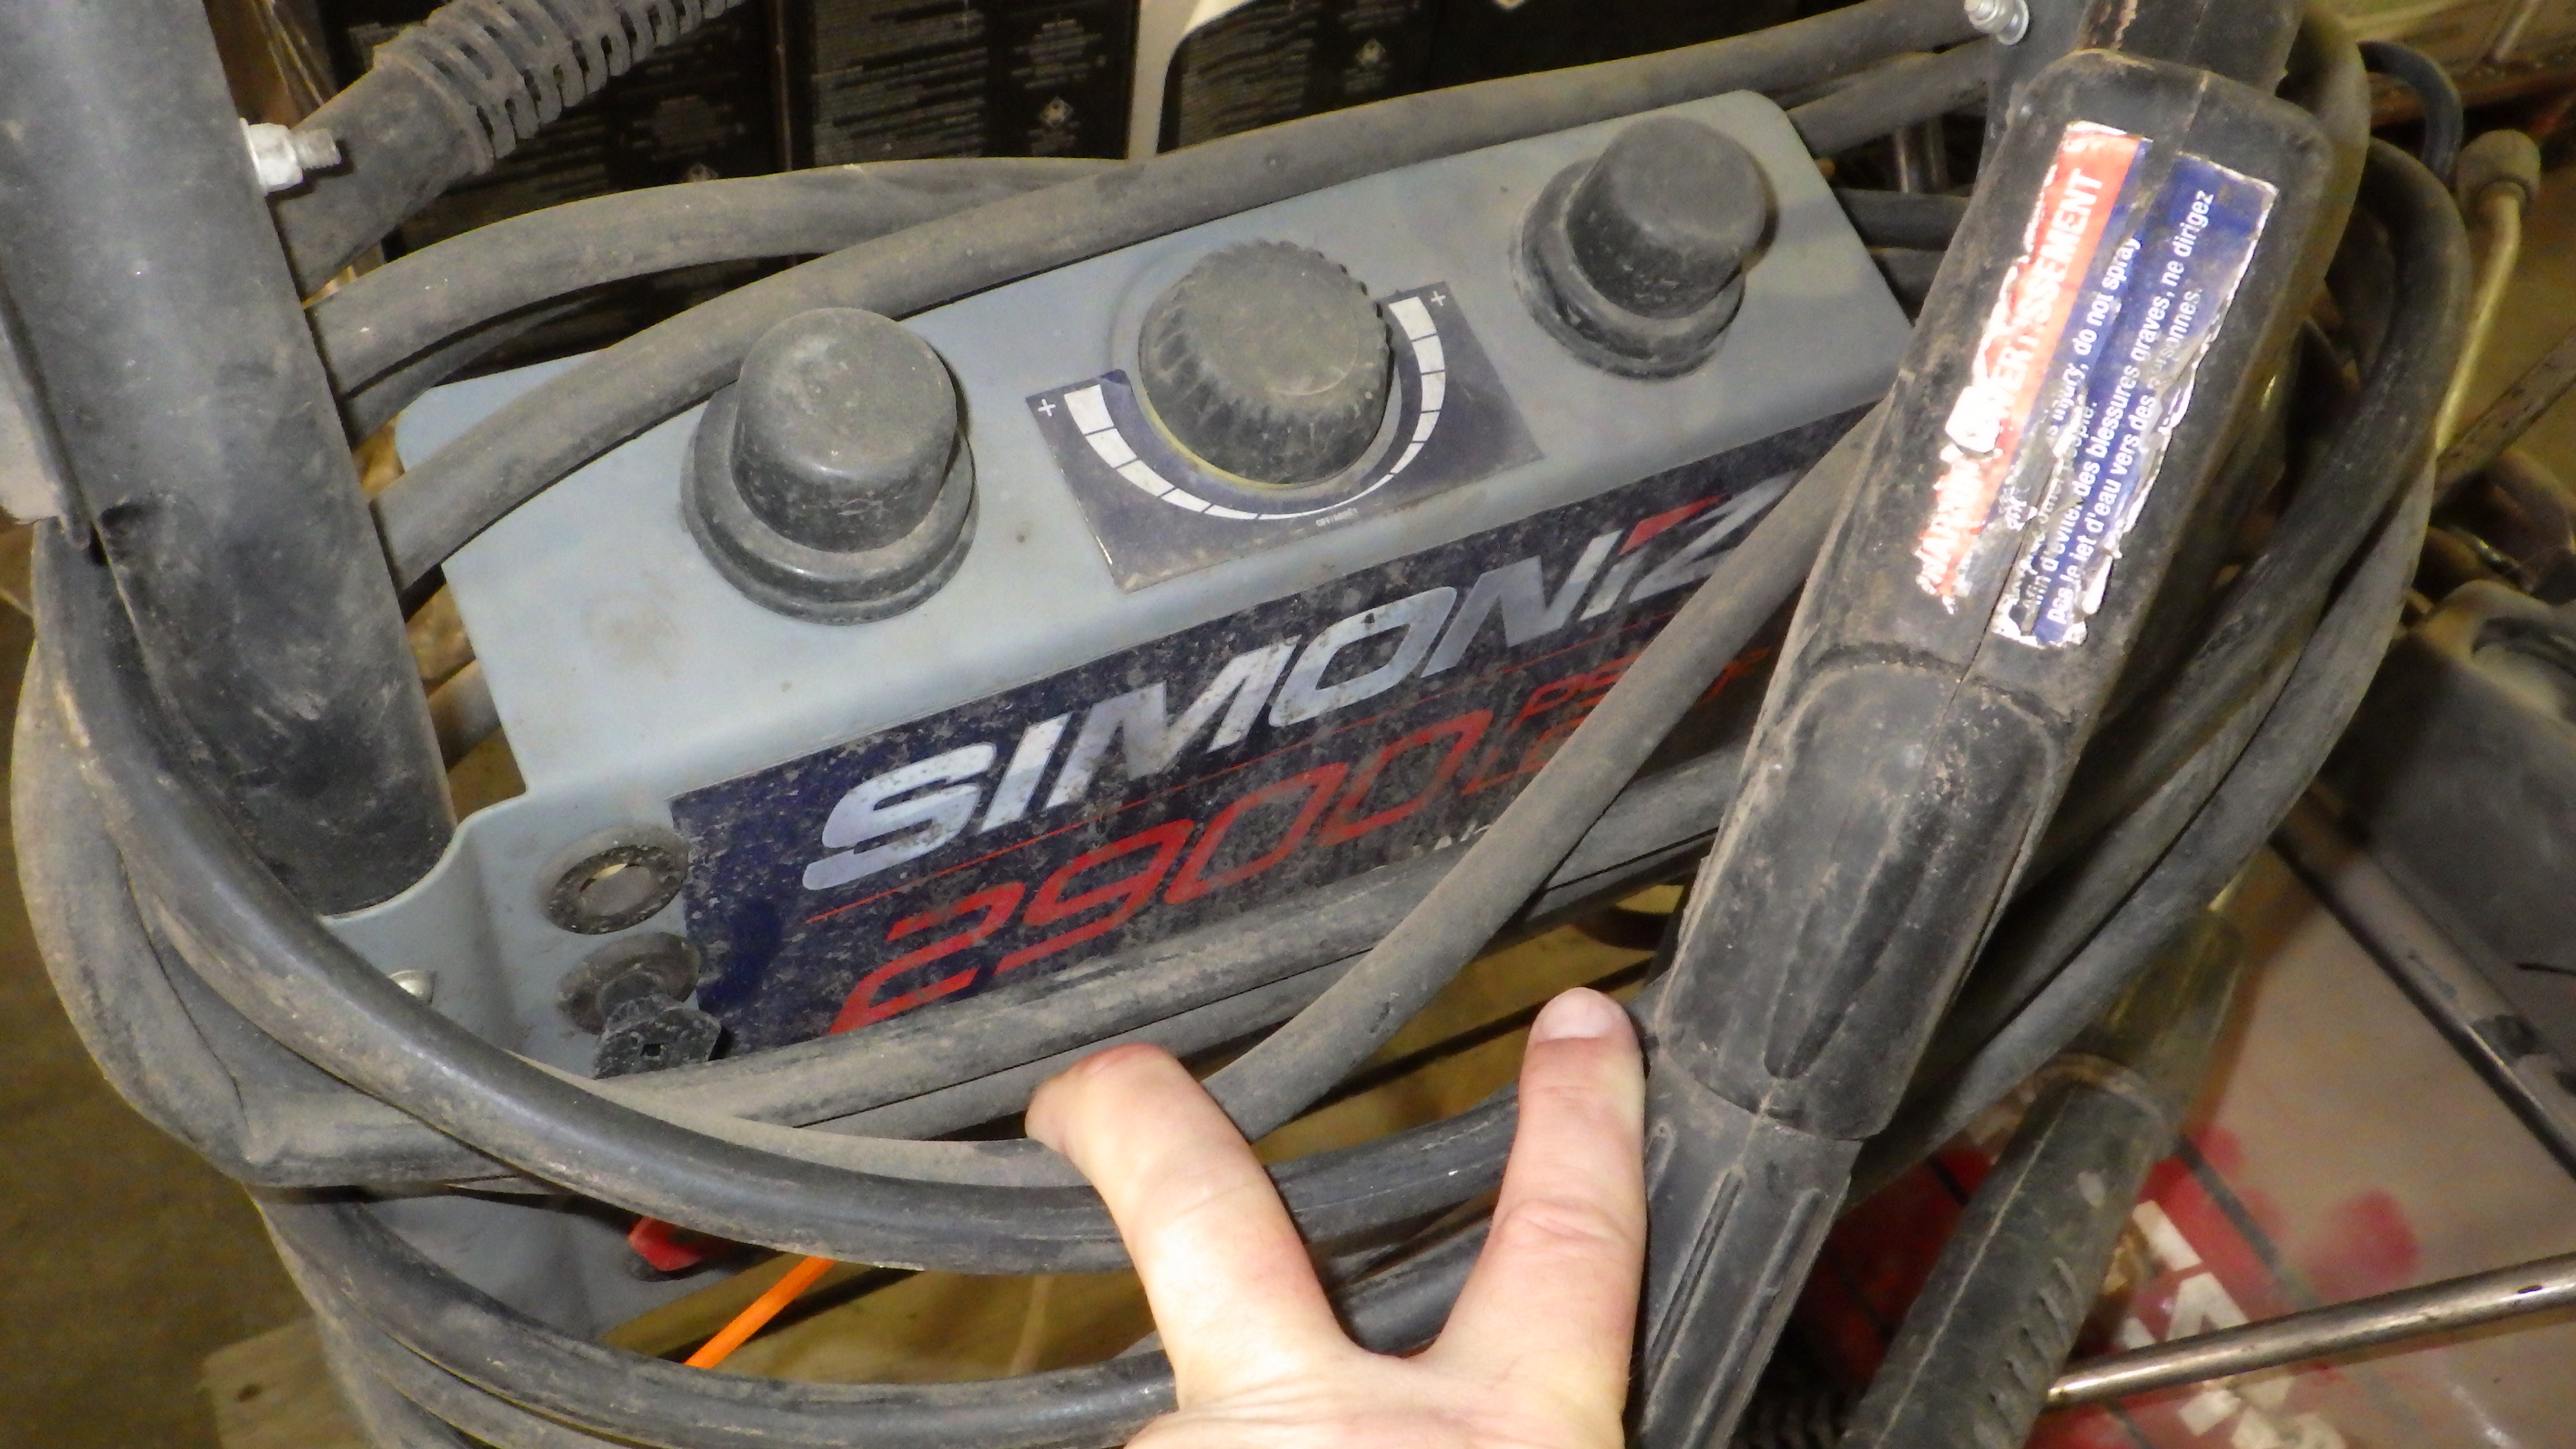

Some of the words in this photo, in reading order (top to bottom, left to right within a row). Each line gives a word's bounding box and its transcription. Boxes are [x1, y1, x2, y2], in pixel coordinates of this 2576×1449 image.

[2172, 189, 2214, 257] dirigez
[2160, 259, 2184, 287] ne
[2072, 326, 2098, 356] do
[2087, 290, 2114, 326] not
[2129, 290, 2175, 362] graves,
[2085, 363, 2141, 458] blessures
[2045, 585, 2075, 624] pas
[2083, 477, 2122, 534] d'eau
[2110, 432, 2141, 473] vers
[2128, 392, 2156, 431] des
[2073, 459, 2101, 496] des
[1915, 464, 1980, 583] WARNIN
[803, 469, 1798, 891] SIMONIZ
[829, 709, 1494, 1034] 2900
